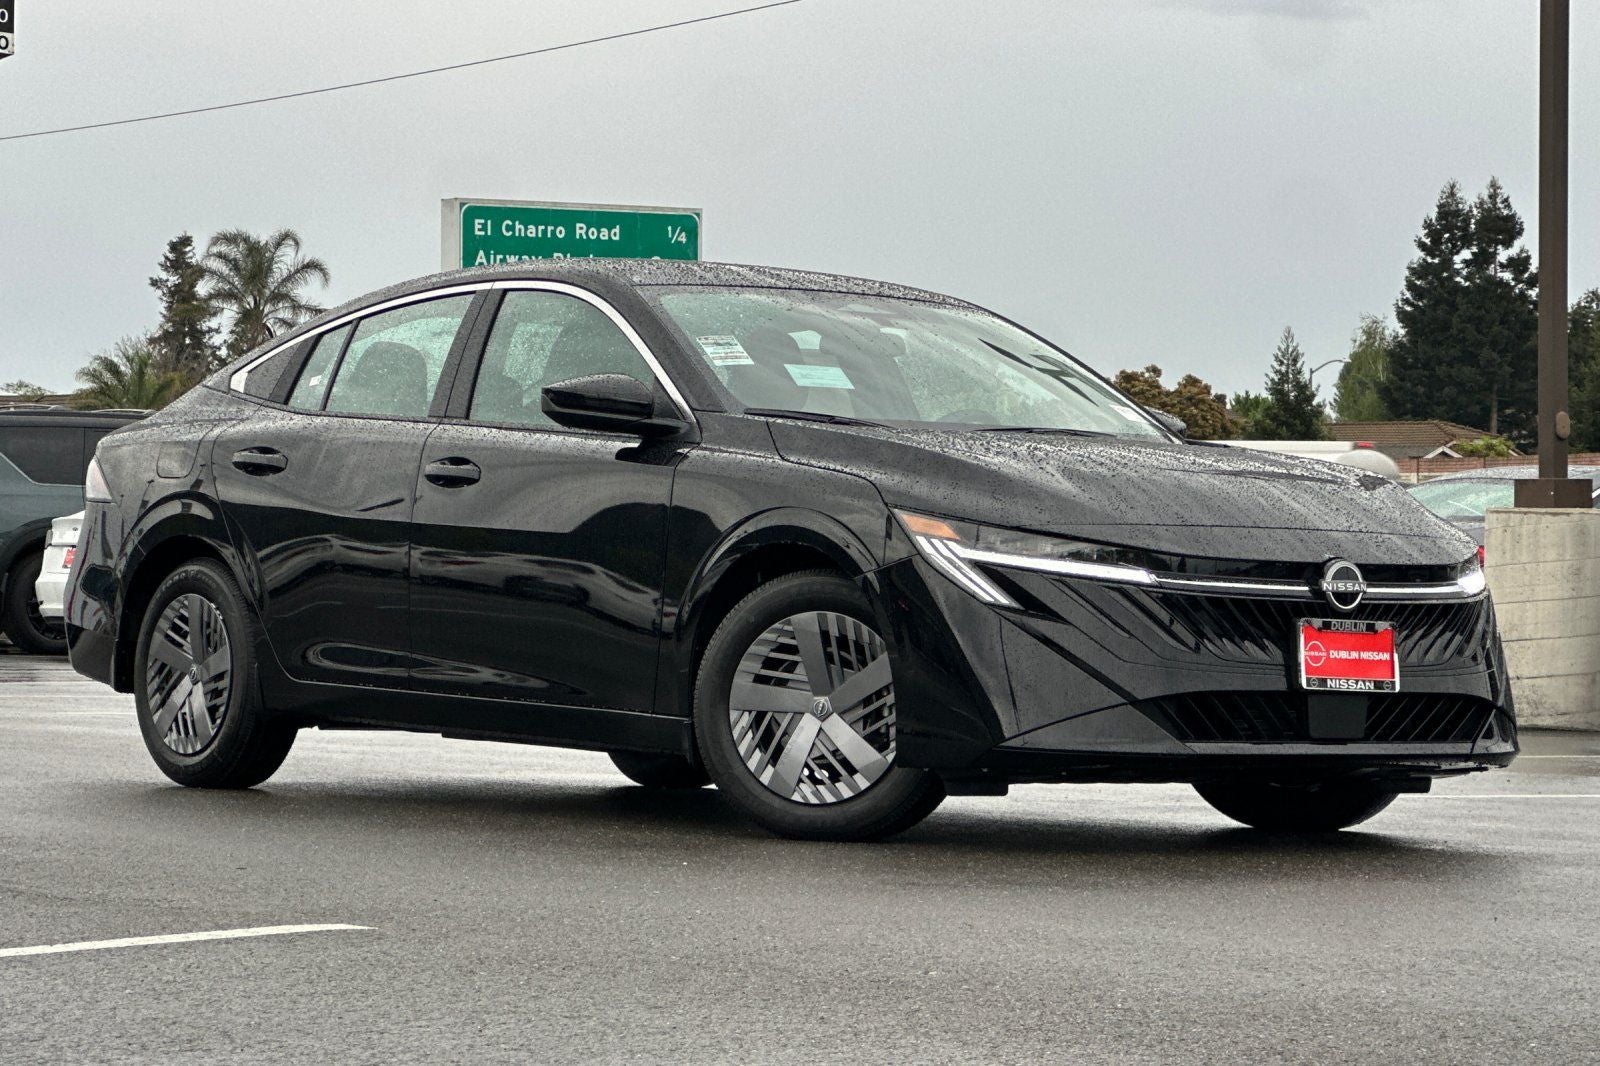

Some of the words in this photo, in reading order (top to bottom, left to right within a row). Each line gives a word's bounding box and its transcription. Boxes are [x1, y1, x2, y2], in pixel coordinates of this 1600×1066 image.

[474, 219, 492, 236] El
[501, 220, 566, 238] Charro
[575, 223, 620, 240] Road
[667, 226, 687, 244] 1/4
[475, 250, 541, 265] Airw
[1323, 583, 1367, 591] NISSAN
[1331, 621, 1367, 632] DUBLIN
[1329, 650, 1359, 660] DUBLIN
[1360, 652, 1390, 661] NISSAN
[1327, 679, 1374, 690] NISSAN
